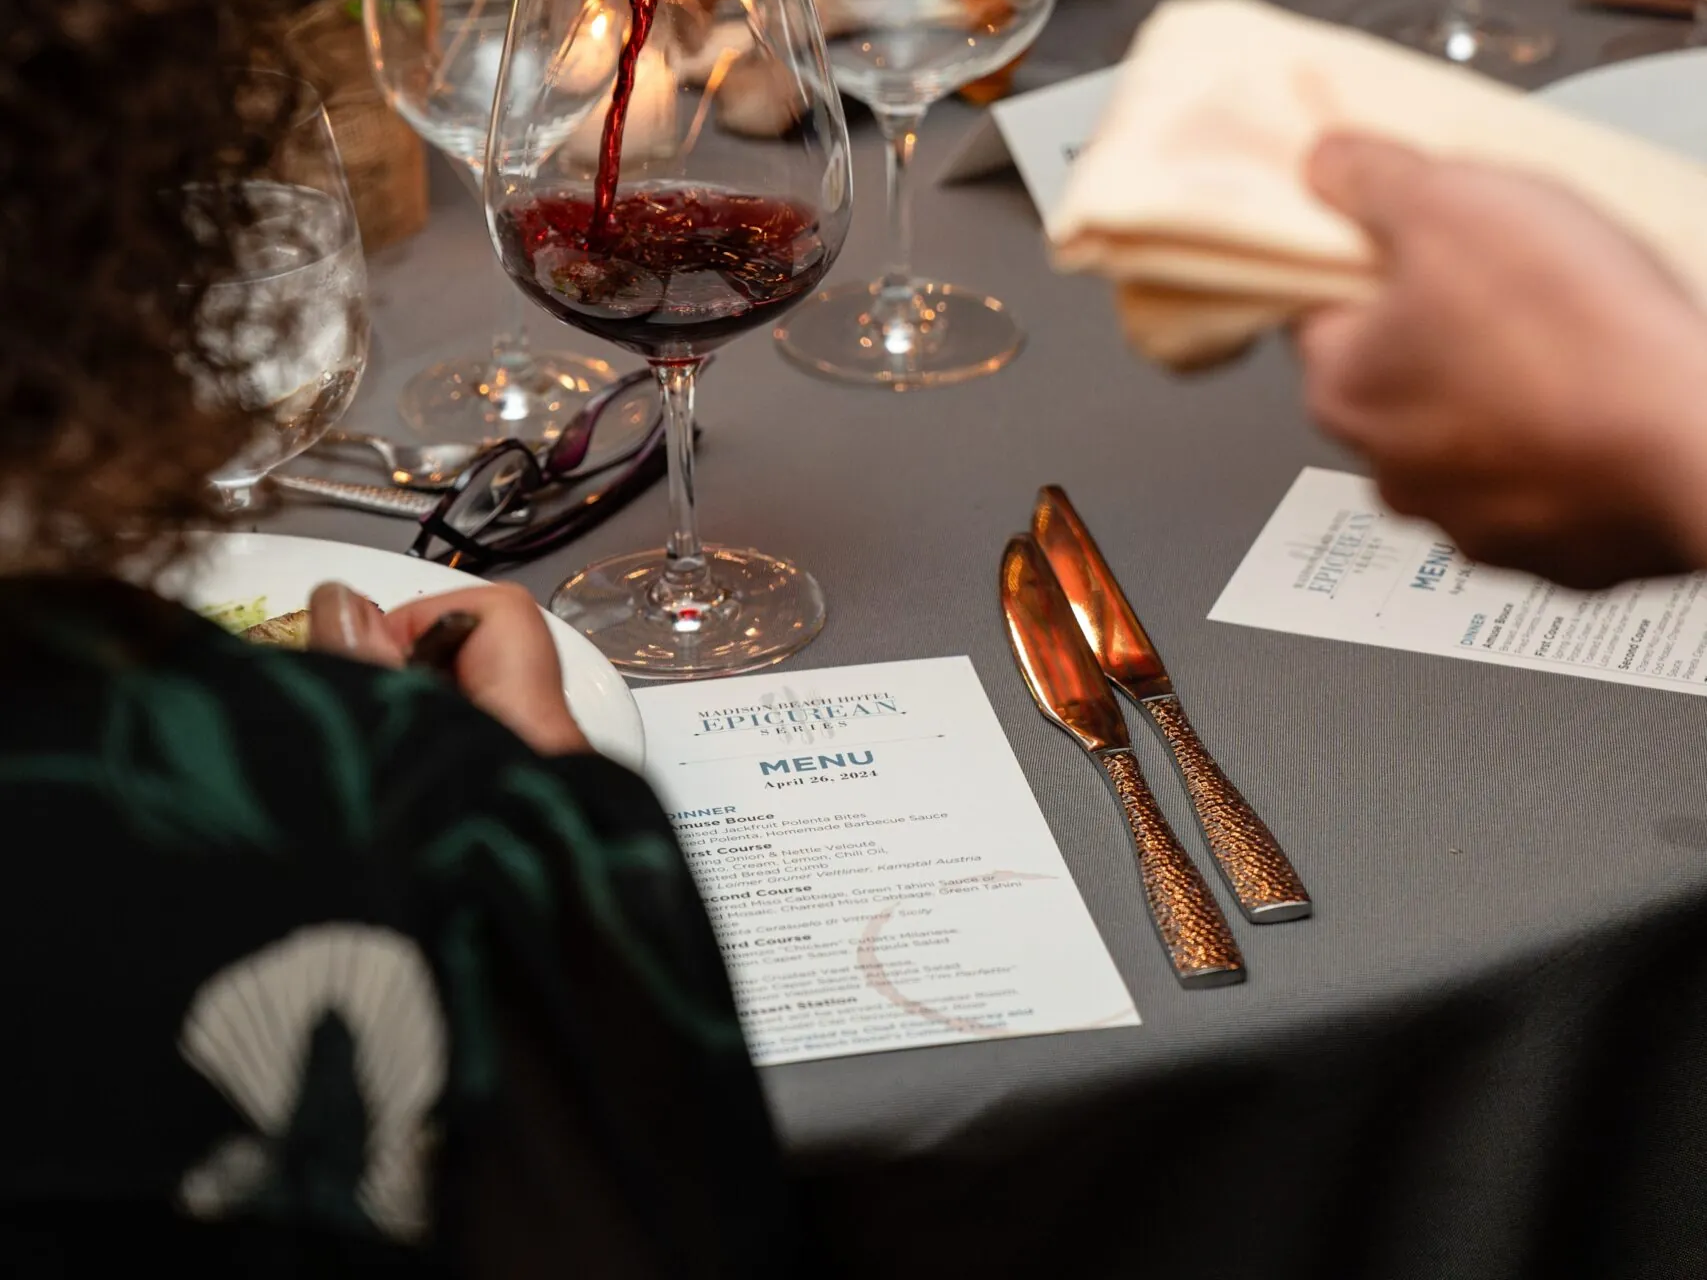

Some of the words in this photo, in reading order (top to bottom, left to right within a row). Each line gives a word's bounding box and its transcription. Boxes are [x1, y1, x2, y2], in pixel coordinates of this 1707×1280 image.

[1409, 542, 1457, 591] MENU
[1460, 613, 1487, 646] DINNER
[1482, 626, 1502, 648] Amuse
[1535, 641, 1552, 657] First
[1544, 616, 1564, 641] Course
[1618, 644, 1639, 670] Second
[1631, 619, 1651, 642] Course
[698, 704, 772, 718] MADISON
[778, 699, 833, 710] BEACH
[838, 692, 895, 704] HOTEL
[702, 699, 899, 733] EPICUREAN
[760, 720, 848, 736] SERIES
[759, 750, 874, 776] MENU
[764, 777, 804, 790] April
[809, 775, 835, 784] 26,
[840, 770, 879, 781] 2024
[678, 828, 718, 840] raised
[721, 822, 778, 834] Jackfruit
[782, 816, 831, 827] Polenta
[834, 811, 867, 821] Bites
[725, 814, 775, 824] Bouce
[679, 836, 706, 848] ried
[709, 833, 763, 844] Polenta,
[766, 823, 840, 837] Homemade
[844, 817, 906, 828] Barbecue
[909, 812, 948, 821] Sauce
[685, 850, 712, 859] irst
[717, 843, 772, 855] Course
[725, 853, 765, 863] Onion
[781, 846, 822, 857] Nettle
[935, 855, 982, 865] Austria
[688, 866, 729, 876] otato,
[782, 854, 832, 866] Lemon,
[835, 850, 863, 859] Chili
[741, 868, 780, 878] Bread
[784, 862, 829, 873] Crumb
[756, 885, 812, 897] Course
[852, 885, 892, 896] Green
[896, 880, 936, 891] Tahini
[938, 876, 979, 887] Sauce
[938, 884, 980, 896] Green
[983, 880, 1023, 890] Tahini
[754, 934, 812, 947] Course
